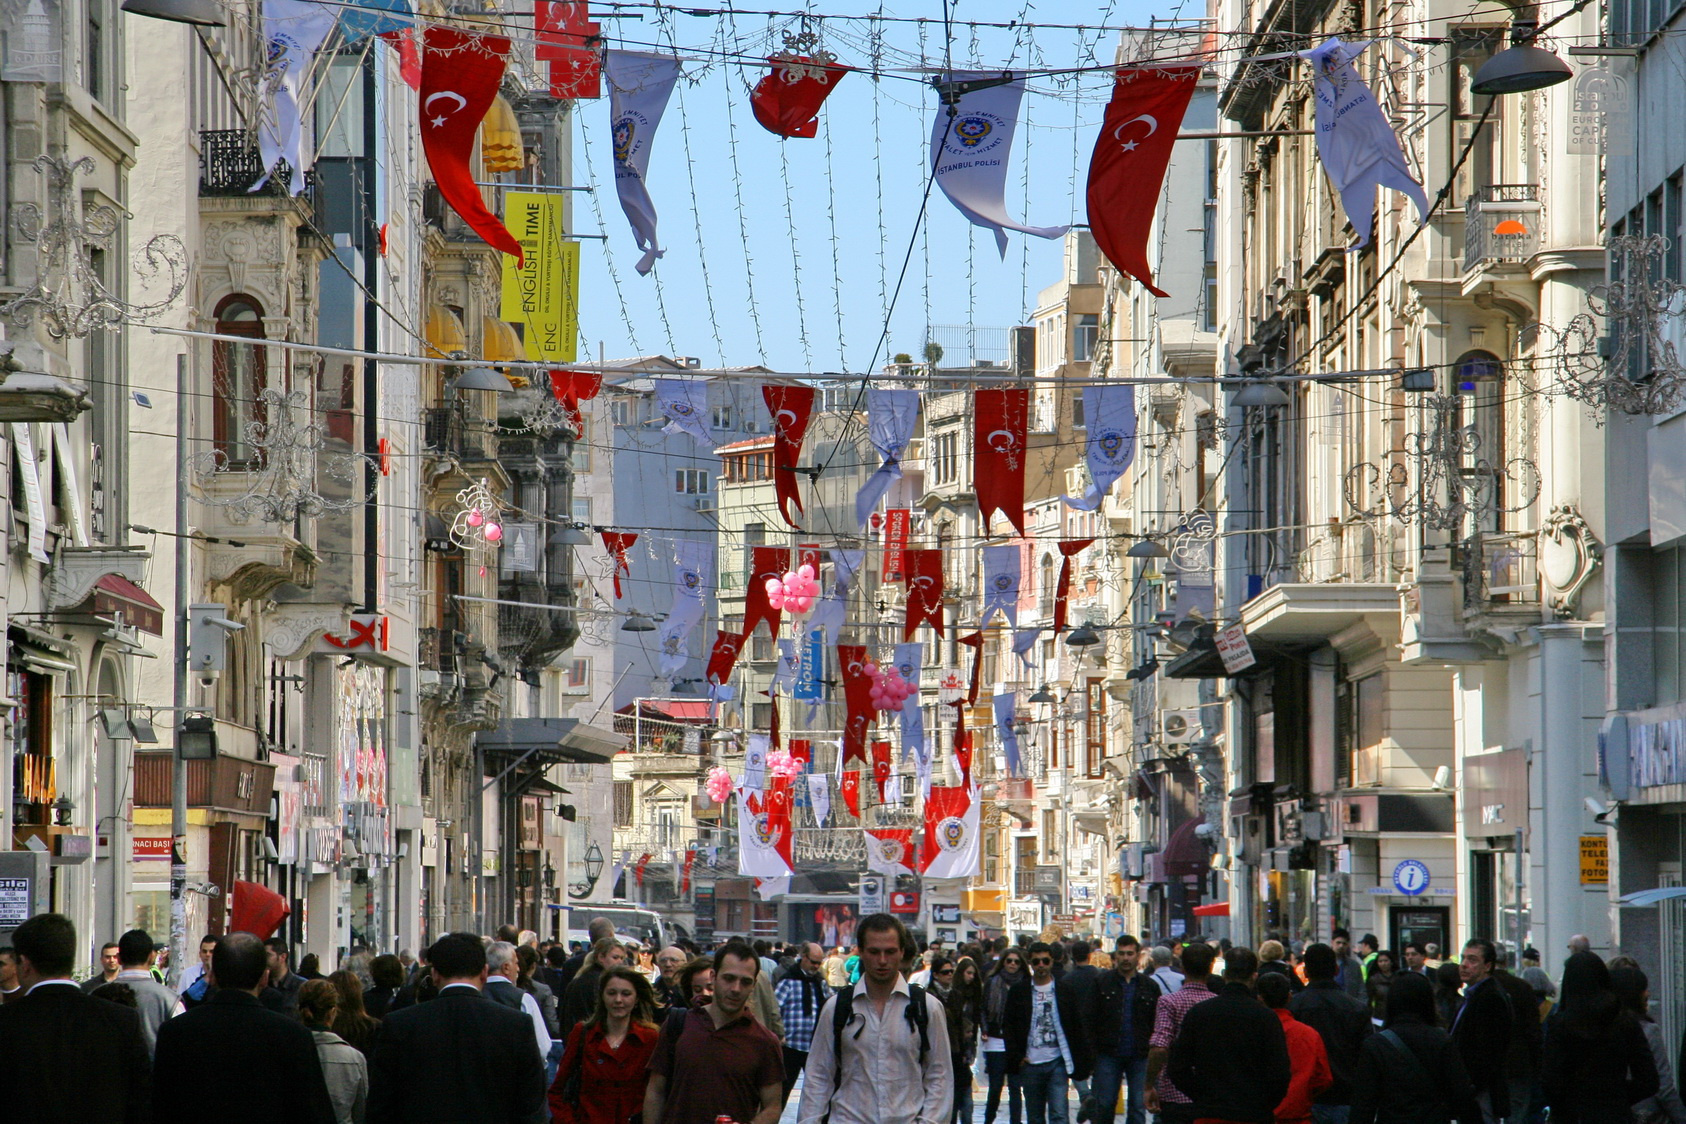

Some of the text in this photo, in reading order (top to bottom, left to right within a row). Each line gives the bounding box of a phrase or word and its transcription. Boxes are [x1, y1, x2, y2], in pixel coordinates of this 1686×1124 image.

[937, 159, 1002, 176] İSTANBUL POLİSİ
[525, 202, 540, 236] TIME
[522, 250, 538, 313] ENGLISH
[890, 512, 903, 541] SPOKEN
[889, 543, 902, 572] ENGLISH
[153, 840, 170, 849] BAŞI
[1581, 850, 1609, 858] TELE
